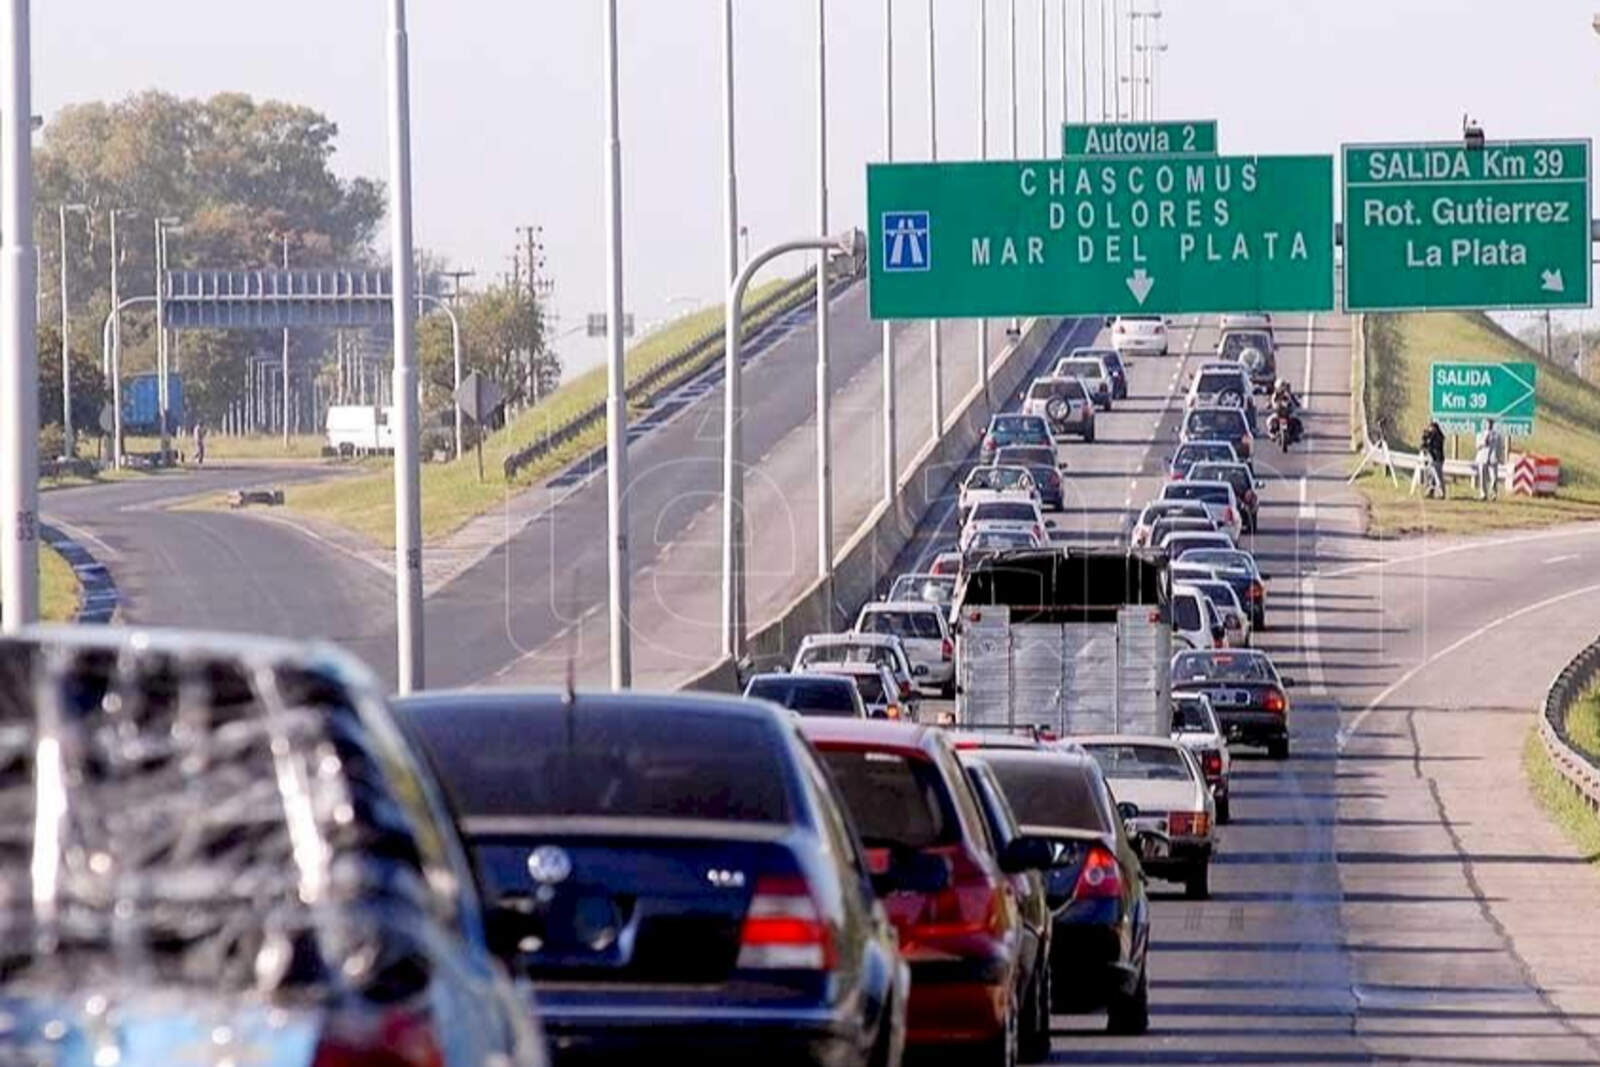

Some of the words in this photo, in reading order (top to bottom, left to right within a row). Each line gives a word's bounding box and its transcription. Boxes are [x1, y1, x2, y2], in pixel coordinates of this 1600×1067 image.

[1084, 127, 1170, 153] Autovia
[1182, 125, 1197, 151] 2
[1369, 151, 1470, 180] SALIDA
[1483, 150, 1525, 177] Km
[1533, 149, 1564, 177] 39
[1020, 164, 1257, 196] CHASCOMUS
[1050, 199, 1230, 230] DOLORES
[1364, 199, 1422, 226] Rot.
[1432, 197, 1570, 225] Gutierrez
[971, 236, 1045, 266] MAR
[1078, 235, 1147, 264] DEL
[1180, 231, 1308, 262] PLATA
[1407, 240, 1442, 267] La
[1451, 239, 1527, 266] Plata
[1436, 369, 1492, 387] SALIDA
[1441, 391, 1466, 409] Km
[1469, 392, 1487, 409] 39
